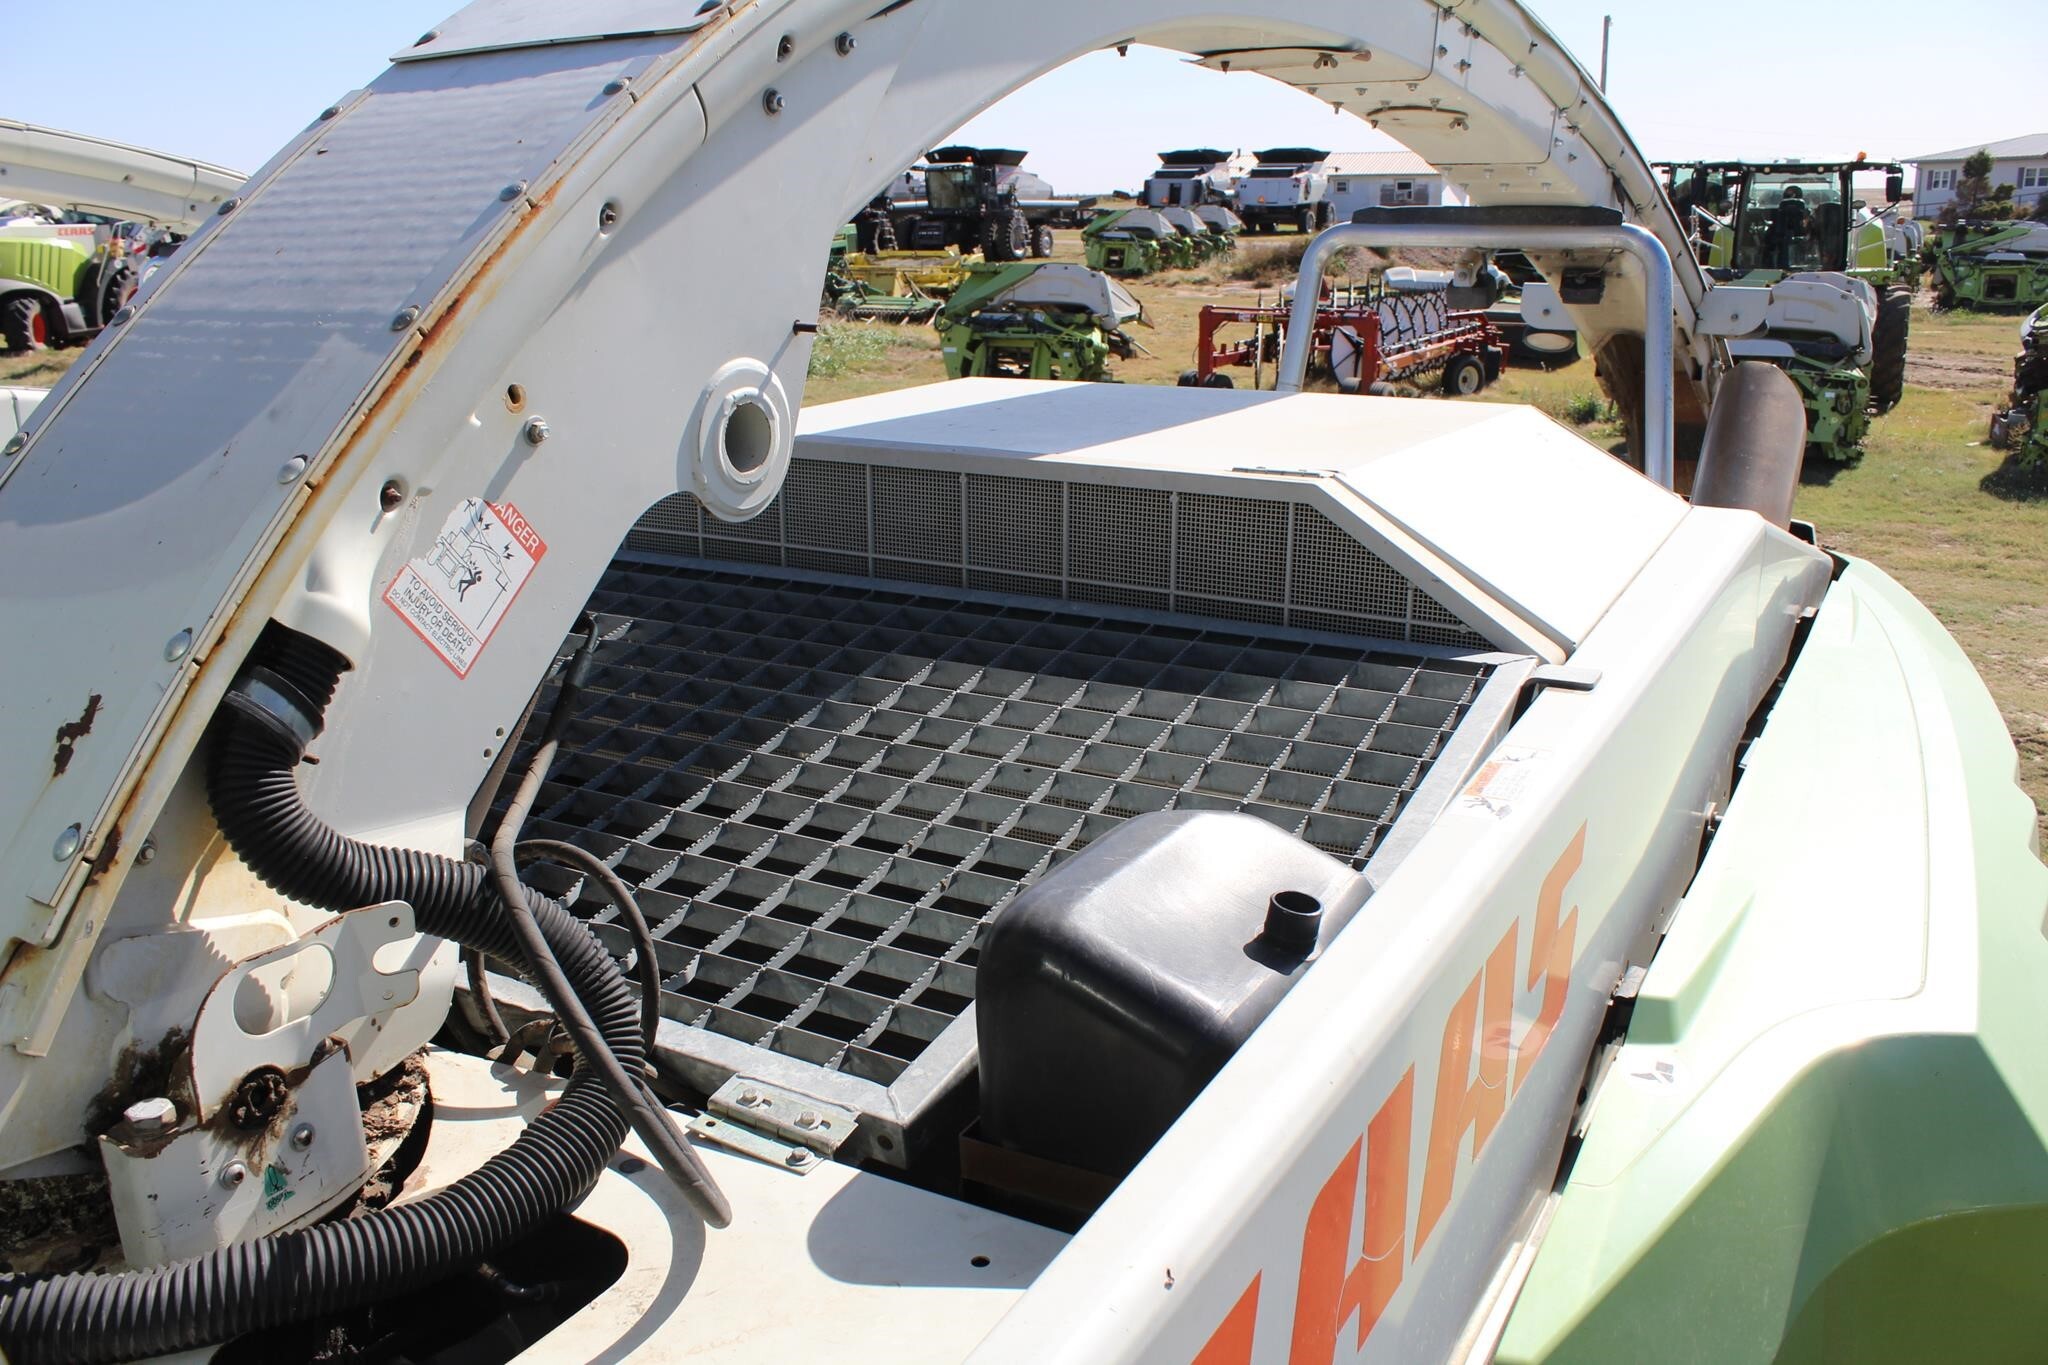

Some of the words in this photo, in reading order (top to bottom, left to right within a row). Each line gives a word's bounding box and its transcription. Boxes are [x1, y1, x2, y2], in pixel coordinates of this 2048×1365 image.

[491, 502, 540, 554] ANGER
[391, 589, 402, 600] DO
[400, 597, 412, 609] NOT
[410, 608, 433, 632] CONTACT
[431, 630, 454, 655] ELECTRIC
[453, 652, 468, 669] LINES
[403, 587, 432, 617] INJURY
[430, 615, 444, 631] OR
[441, 628, 467, 655] DEATH
[409, 575, 422, 591] TO
[420, 589, 443, 614] AVOID
[442, 611, 474, 646] SERIOUS
[1190, 819, 1587, 1365] AAS
